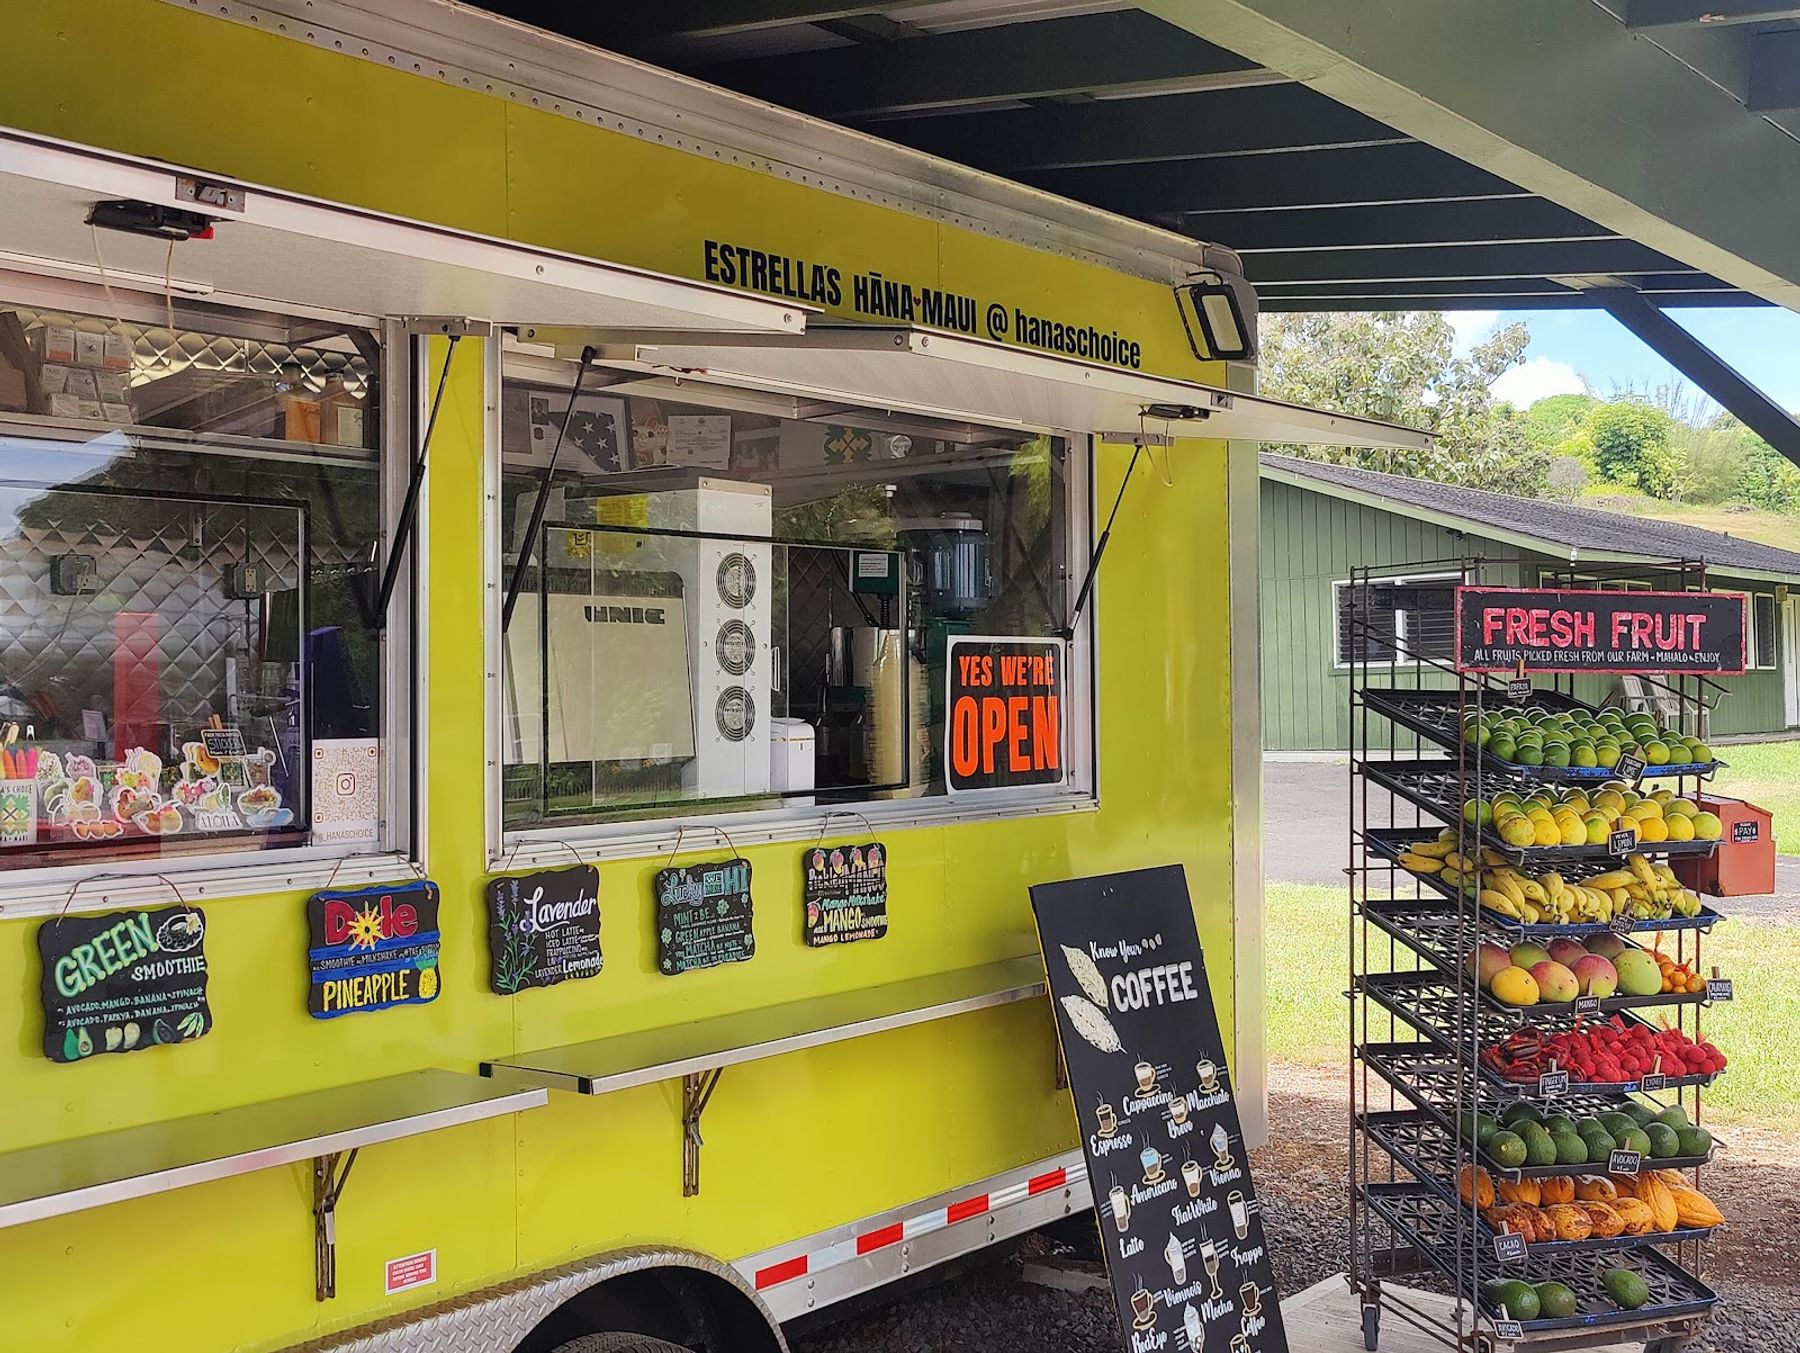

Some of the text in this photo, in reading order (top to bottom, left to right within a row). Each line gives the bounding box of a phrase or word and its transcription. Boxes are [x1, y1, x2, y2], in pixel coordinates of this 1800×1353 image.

[921, 288, 977, 334] MAUI
[986, 303, 1009, 342] @
[1015, 308, 1141, 369] hanaschoice
[1482, 607, 1707, 650] FRESH FRUIT
[1474, 649, 1490, 661] ALL
[1492, 649, 1522, 662] FRUITS
[1523, 650, 1553, 662] PICKED
[1553, 650, 1580, 662] FRESH
[1581, 650, 1605, 662] FROM
[1607, 651, 1625, 663] OUR
[1626, 651, 1649, 663] FARM
[959, 655, 1055, 687] YES WE'RE
[953, 695, 1059, 778] OPEN
[1738, 826, 1753, 836] PAY
[661, 872, 704, 906] Lucky
[520, 887, 597, 933] Lavender
[673, 909, 694, 926] MINT
[699, 907, 710, 921] BE
[823, 906, 861, 933] MANGO
[545, 930, 559, 940] HOT
[675, 928, 699, 943] GREEN
[814, 933, 838, 945] MANGO
[55, 912, 159, 997] GREEN
[320, 957, 355, 970] SMOOTHIE
[361, 949, 397, 965] MILKSHAKE
[563, 952, 603, 973] Lemonade
[1089, 939, 1142, 963] Know Your
[131, 956, 206, 982] SMOOTHIE
[134, 992, 167, 1005] BANANA
[323, 969, 411, 1012] PINEAPPLE
[1111, 961, 1198, 1013] COFFEE
[1090, 1133, 1132, 1157] Espresso
[1613, 1153, 1637, 1165] AVOCADO
[1209, 1167, 1242, 1187] Vienna
[1130, 1178, 1178, 1206] Americano
[1119, 1236, 1145, 1259] Latte
[1499, 1239, 1520, 1250] CACAO
[1241, 1316, 1266, 1337] Coffee
